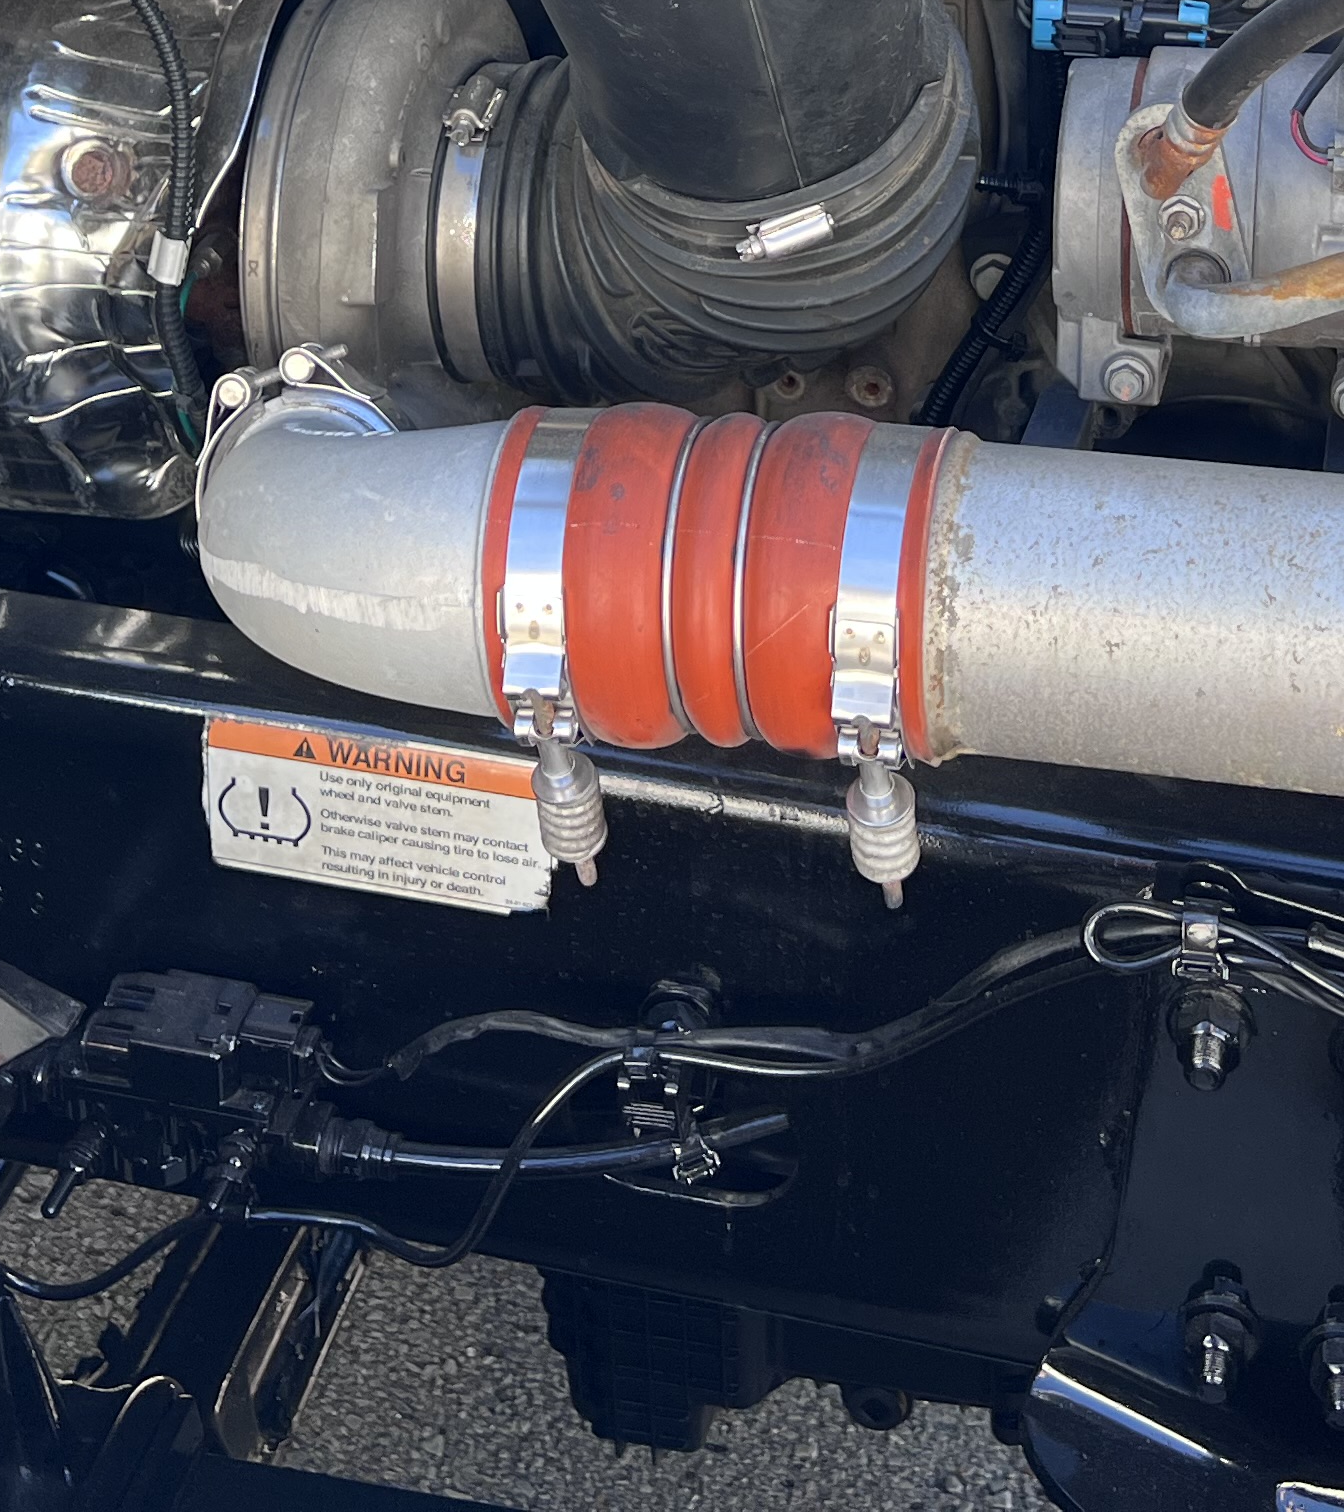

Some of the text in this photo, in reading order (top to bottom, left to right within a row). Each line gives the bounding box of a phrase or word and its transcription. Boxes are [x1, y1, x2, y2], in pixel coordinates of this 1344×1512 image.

[327, 737, 467, 784] WARNING
[319, 769, 491, 810] Use only original equipment
[320, 786, 454, 818] wheel and valve stem.
[320, 807, 529, 853] Otherwise valve stem may contact
[320, 821, 542, 870] brake caliper causing tire to lose air.
[321, 844, 507, 886] This may affect vehicle control
[321, 861, 485, 897] resulting in injury or death.
